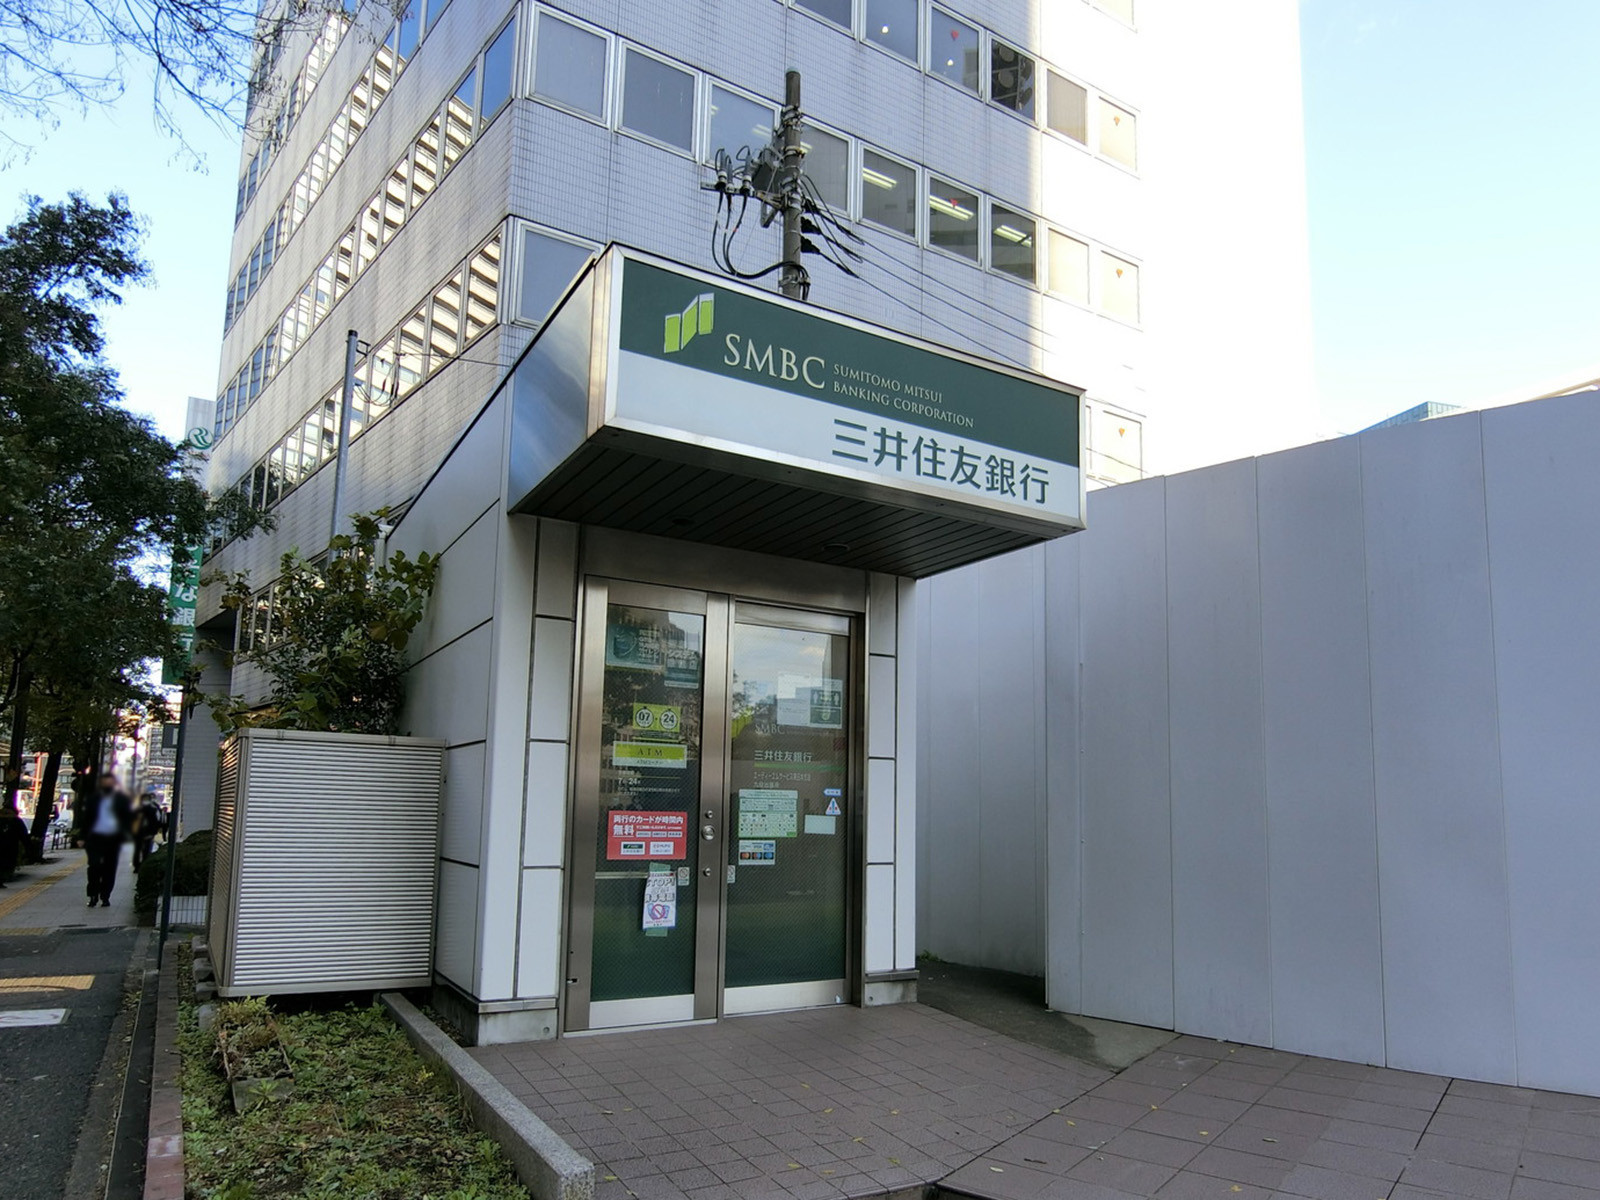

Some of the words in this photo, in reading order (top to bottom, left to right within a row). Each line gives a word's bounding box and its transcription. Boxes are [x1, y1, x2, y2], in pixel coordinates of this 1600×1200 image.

[724, 332, 827, 391] SMBC
[832, 363, 902, 392] SUMITOMO
[902, 382, 944, 404] MITSUI
[832, 380, 890, 407] BANKING
[893, 397, 975, 429] CORPORATION
[831, 418, 1050, 505] 三井住友銀行
[637, 747, 663, 757] ATM
[754, 749, 813, 763] 三井住友銀行
[613, 814, 684, 825] 両行のカードが時間内
[613, 824, 635, 836] 無料
